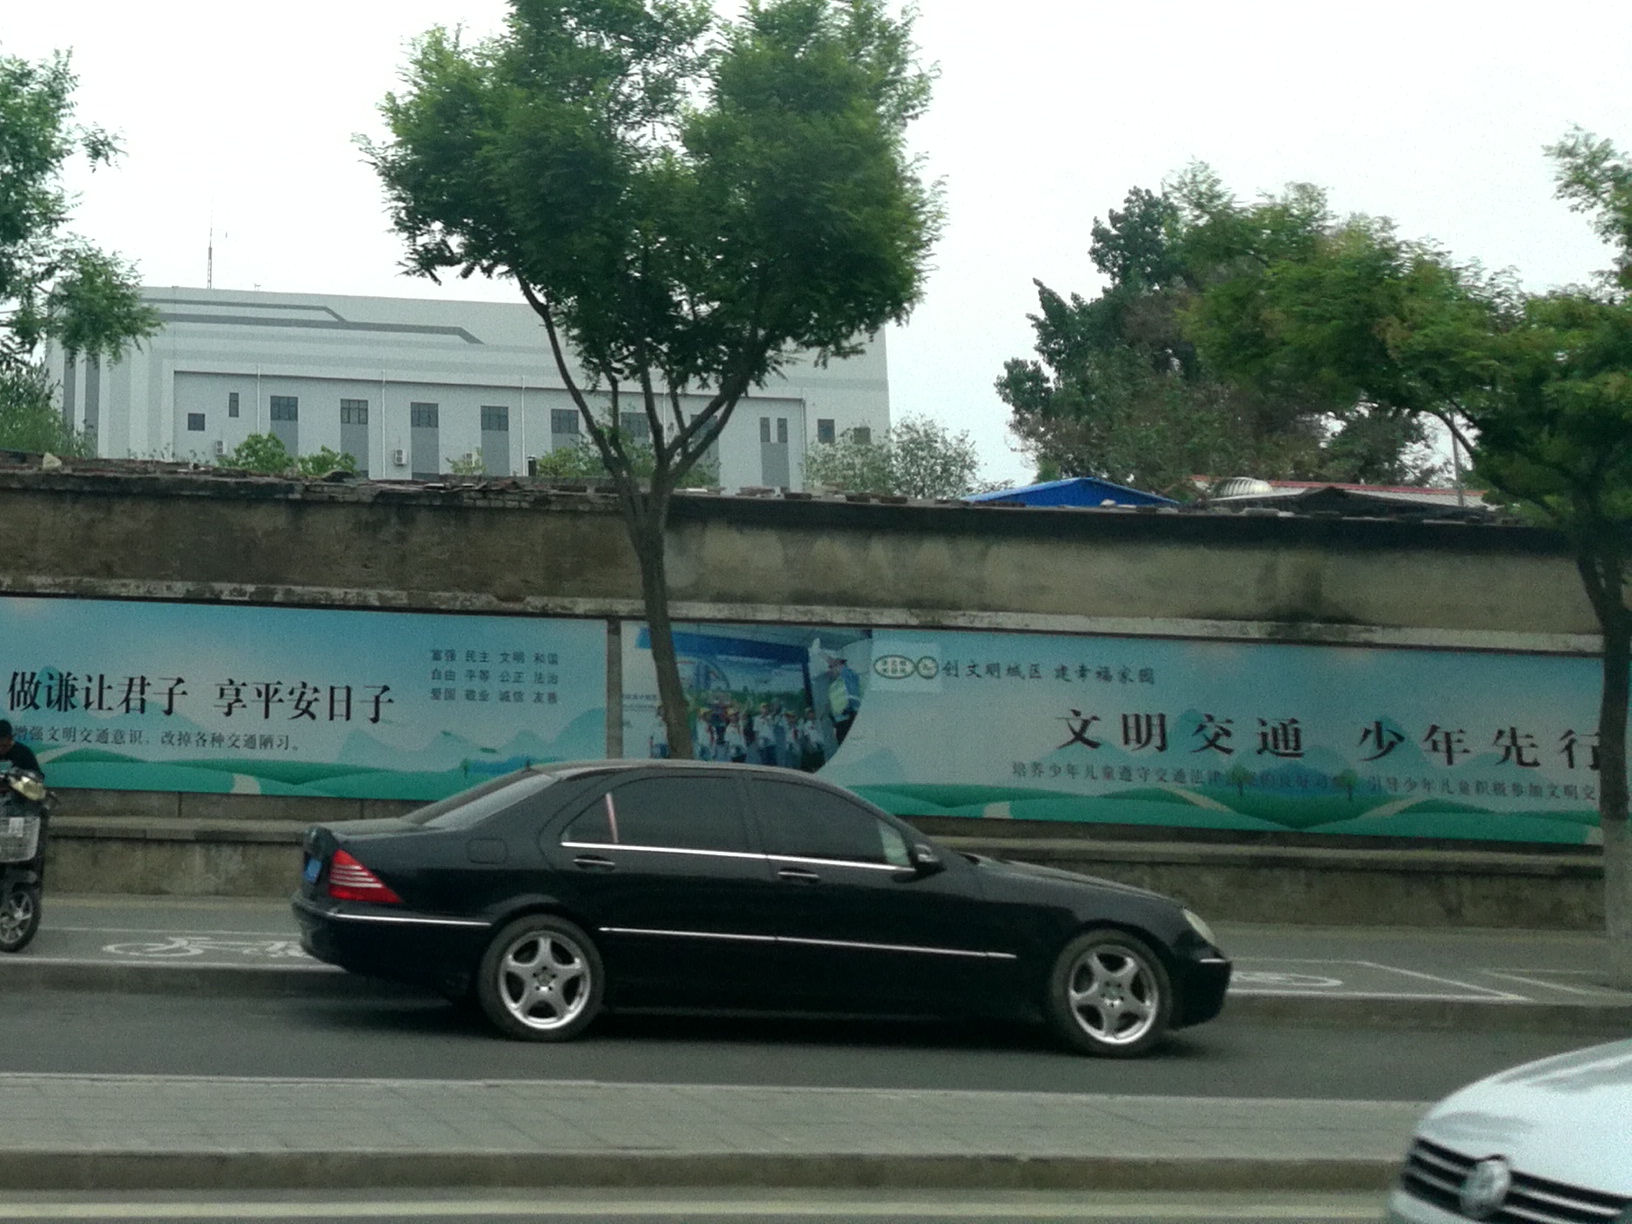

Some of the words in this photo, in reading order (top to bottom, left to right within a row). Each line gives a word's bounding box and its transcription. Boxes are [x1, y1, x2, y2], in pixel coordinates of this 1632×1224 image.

[465, 650, 490, 663] 民主
[431, 668, 457, 681] 自由
[499, 671, 525, 683] 公正
[942, 659, 1043, 681] 创文明城区
[8, 670, 188, 716] 做谦让君子
[213, 678, 395, 724] 享平安日子
[1053, 709, 1305, 760] 文明交通
[1358, 718, 1601, 771] 少年先行
